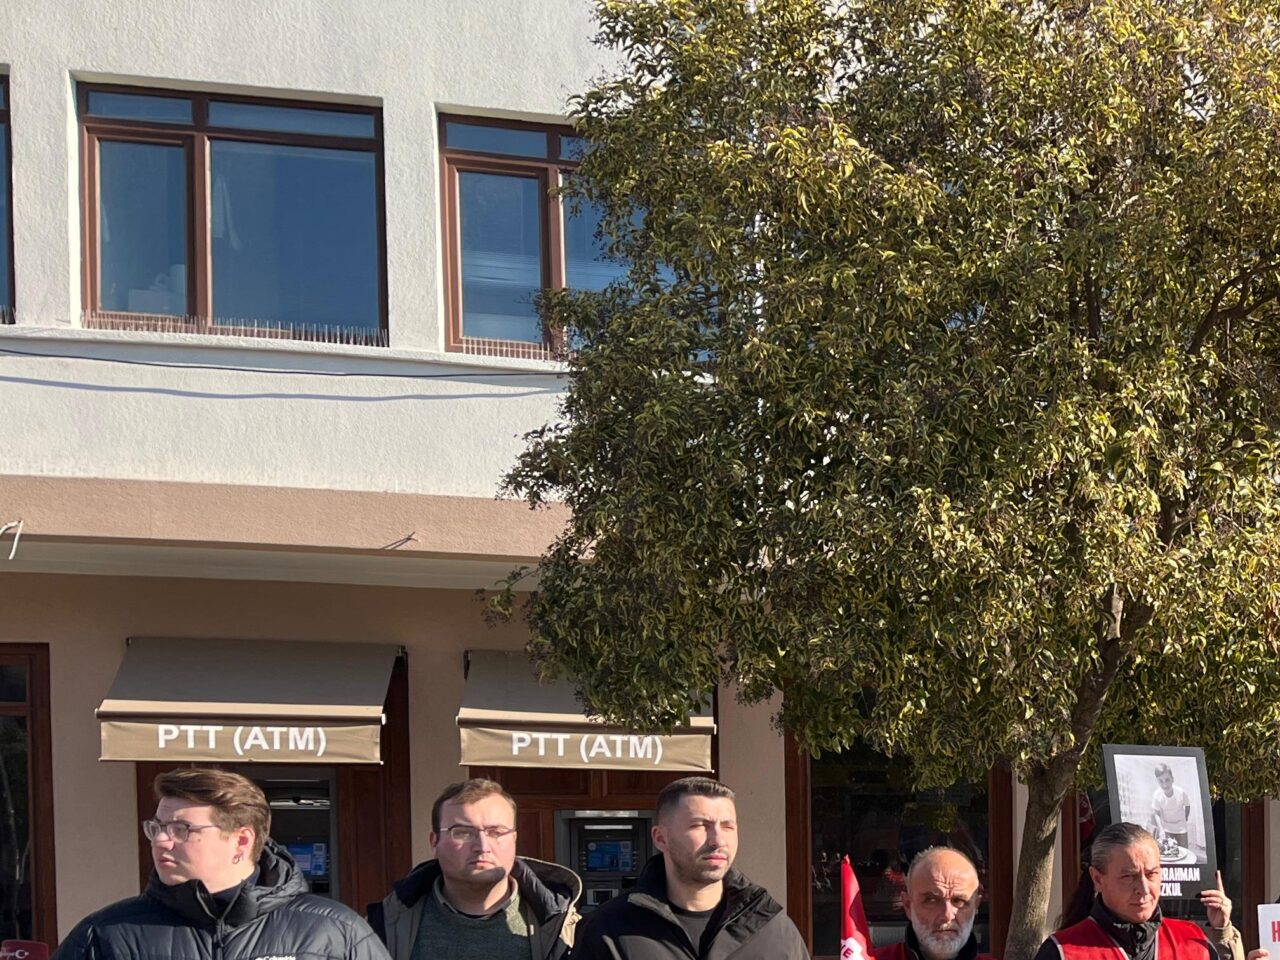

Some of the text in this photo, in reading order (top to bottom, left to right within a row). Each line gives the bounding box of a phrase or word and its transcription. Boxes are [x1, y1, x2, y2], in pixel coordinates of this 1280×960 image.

[158, 724, 327, 757] PTT (ATM)
[512, 732, 663, 765] PTT (ATM)
[1160, 882, 1183, 896] ZKUL
